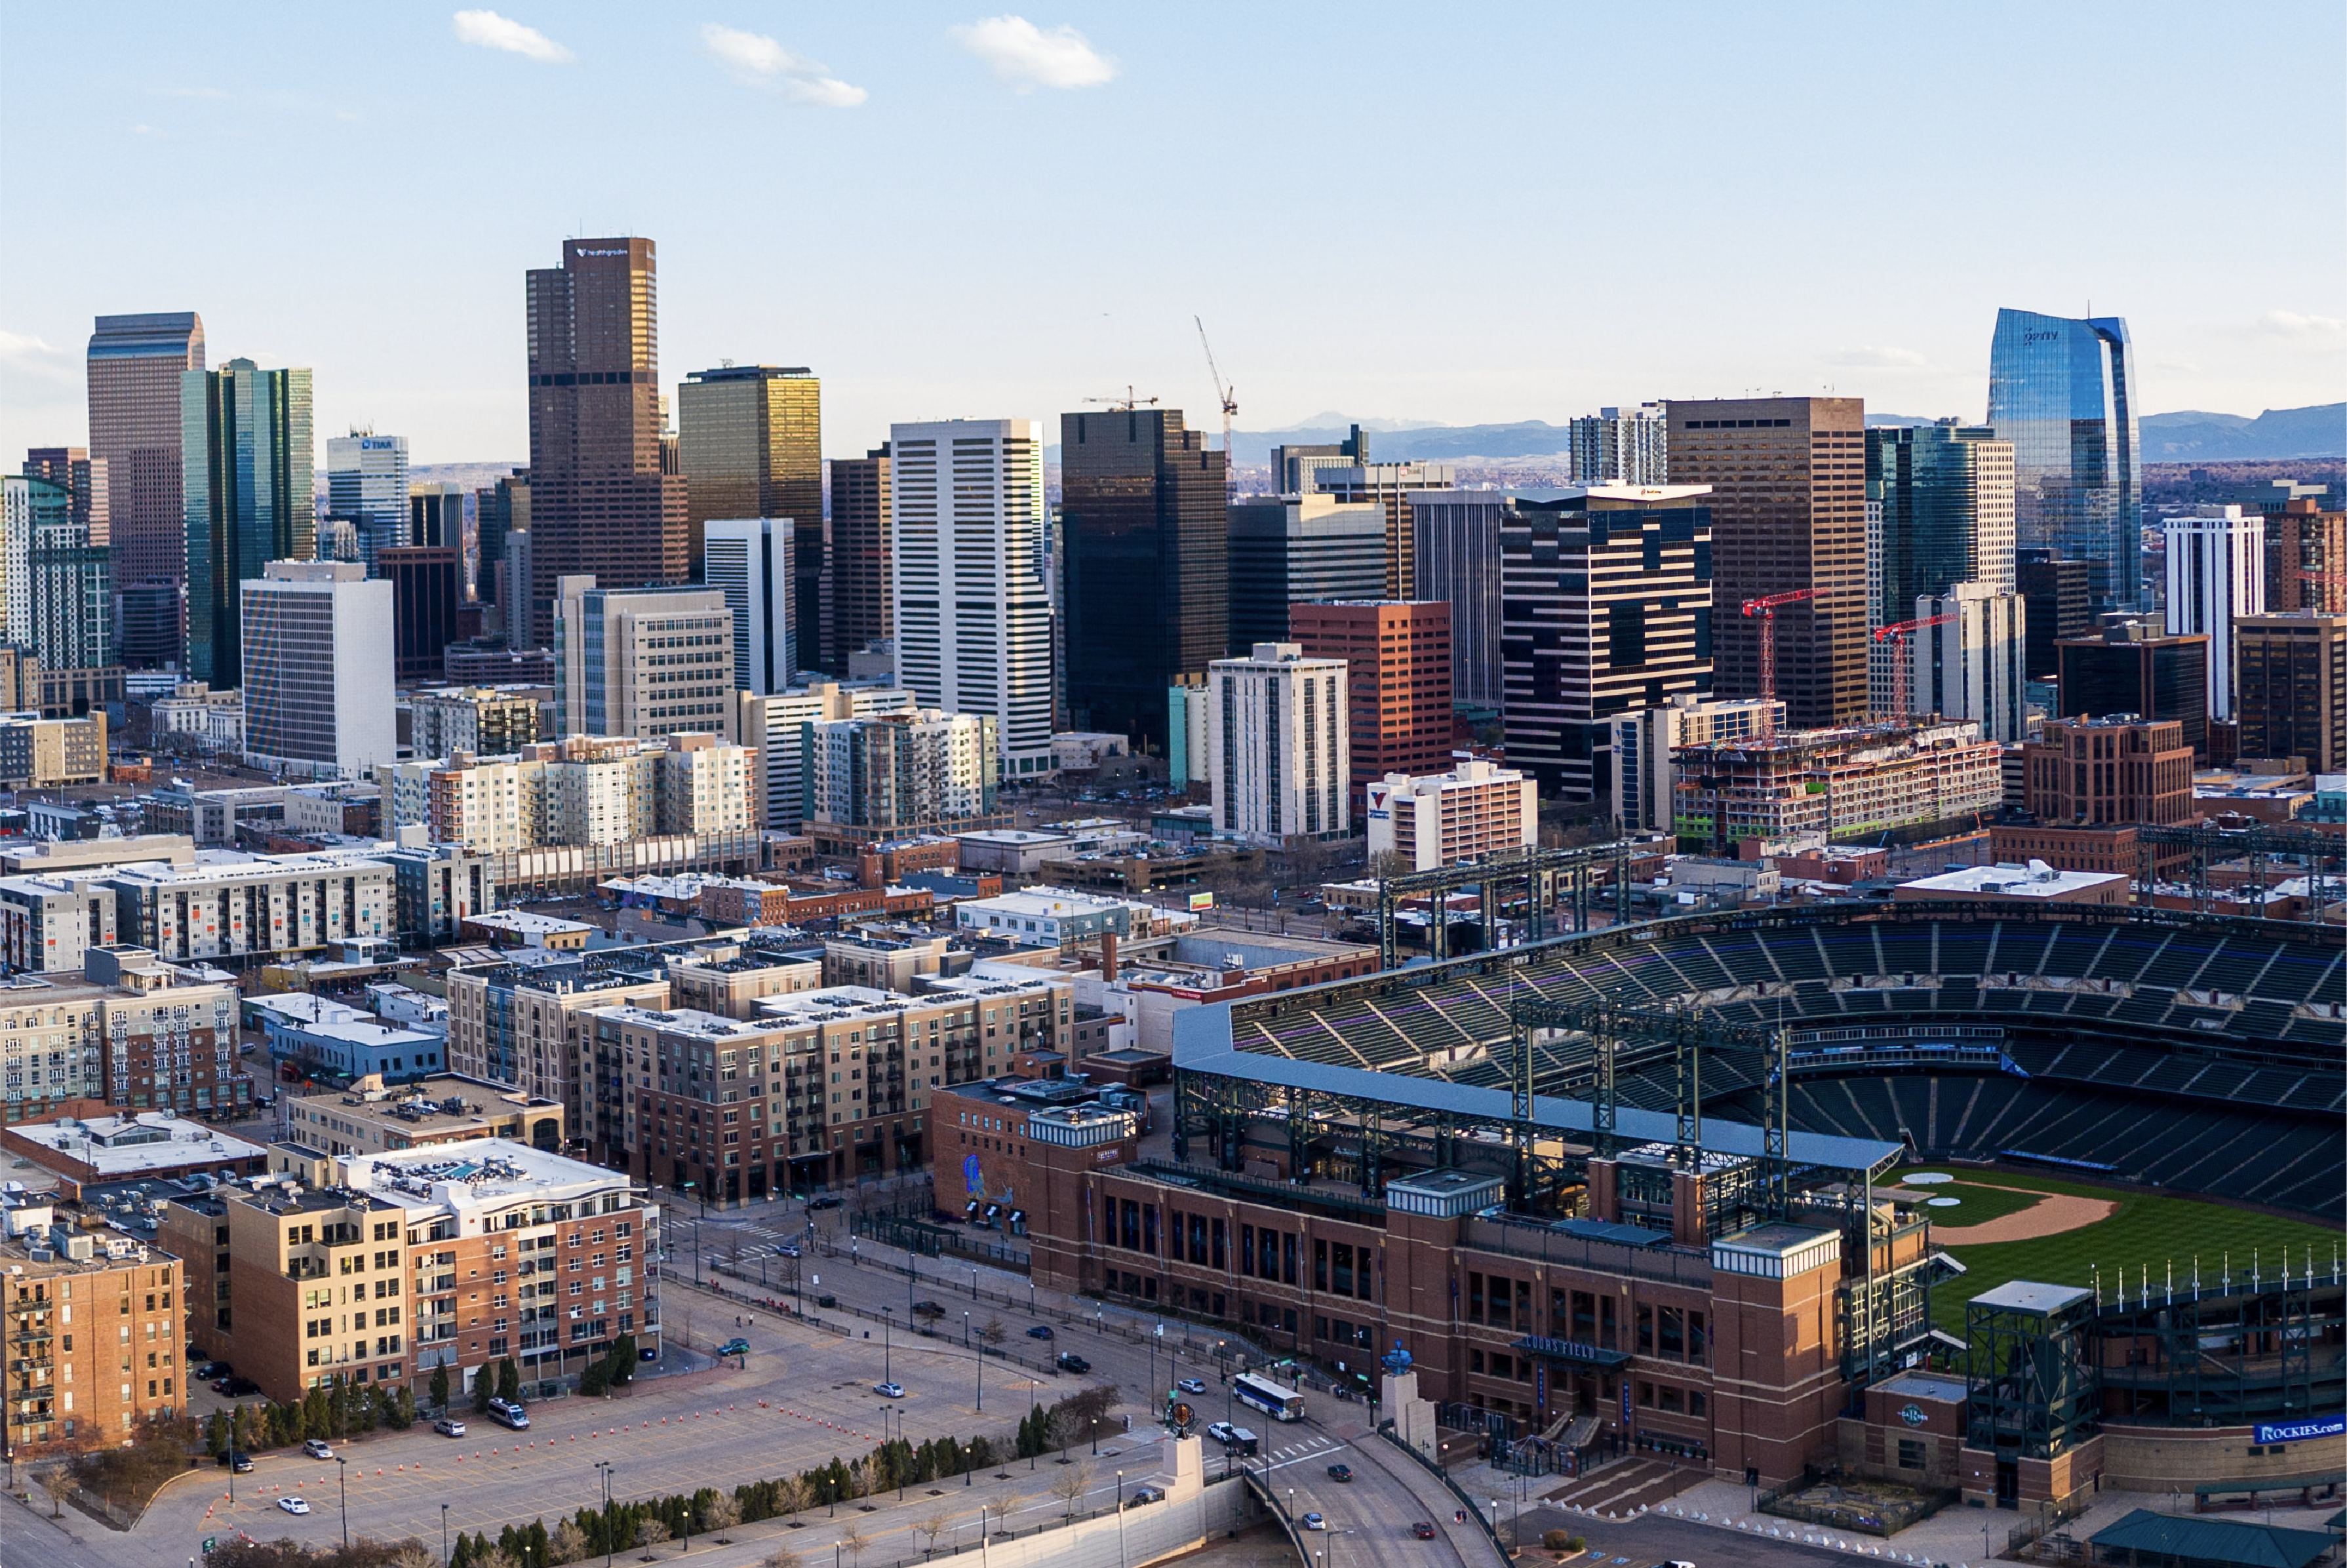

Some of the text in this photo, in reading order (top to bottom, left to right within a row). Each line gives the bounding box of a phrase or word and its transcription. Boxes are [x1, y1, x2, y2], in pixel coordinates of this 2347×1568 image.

[372, 440, 392, 449] TIAA
[1526, 1335, 1595, 1360] COORS FIELD
